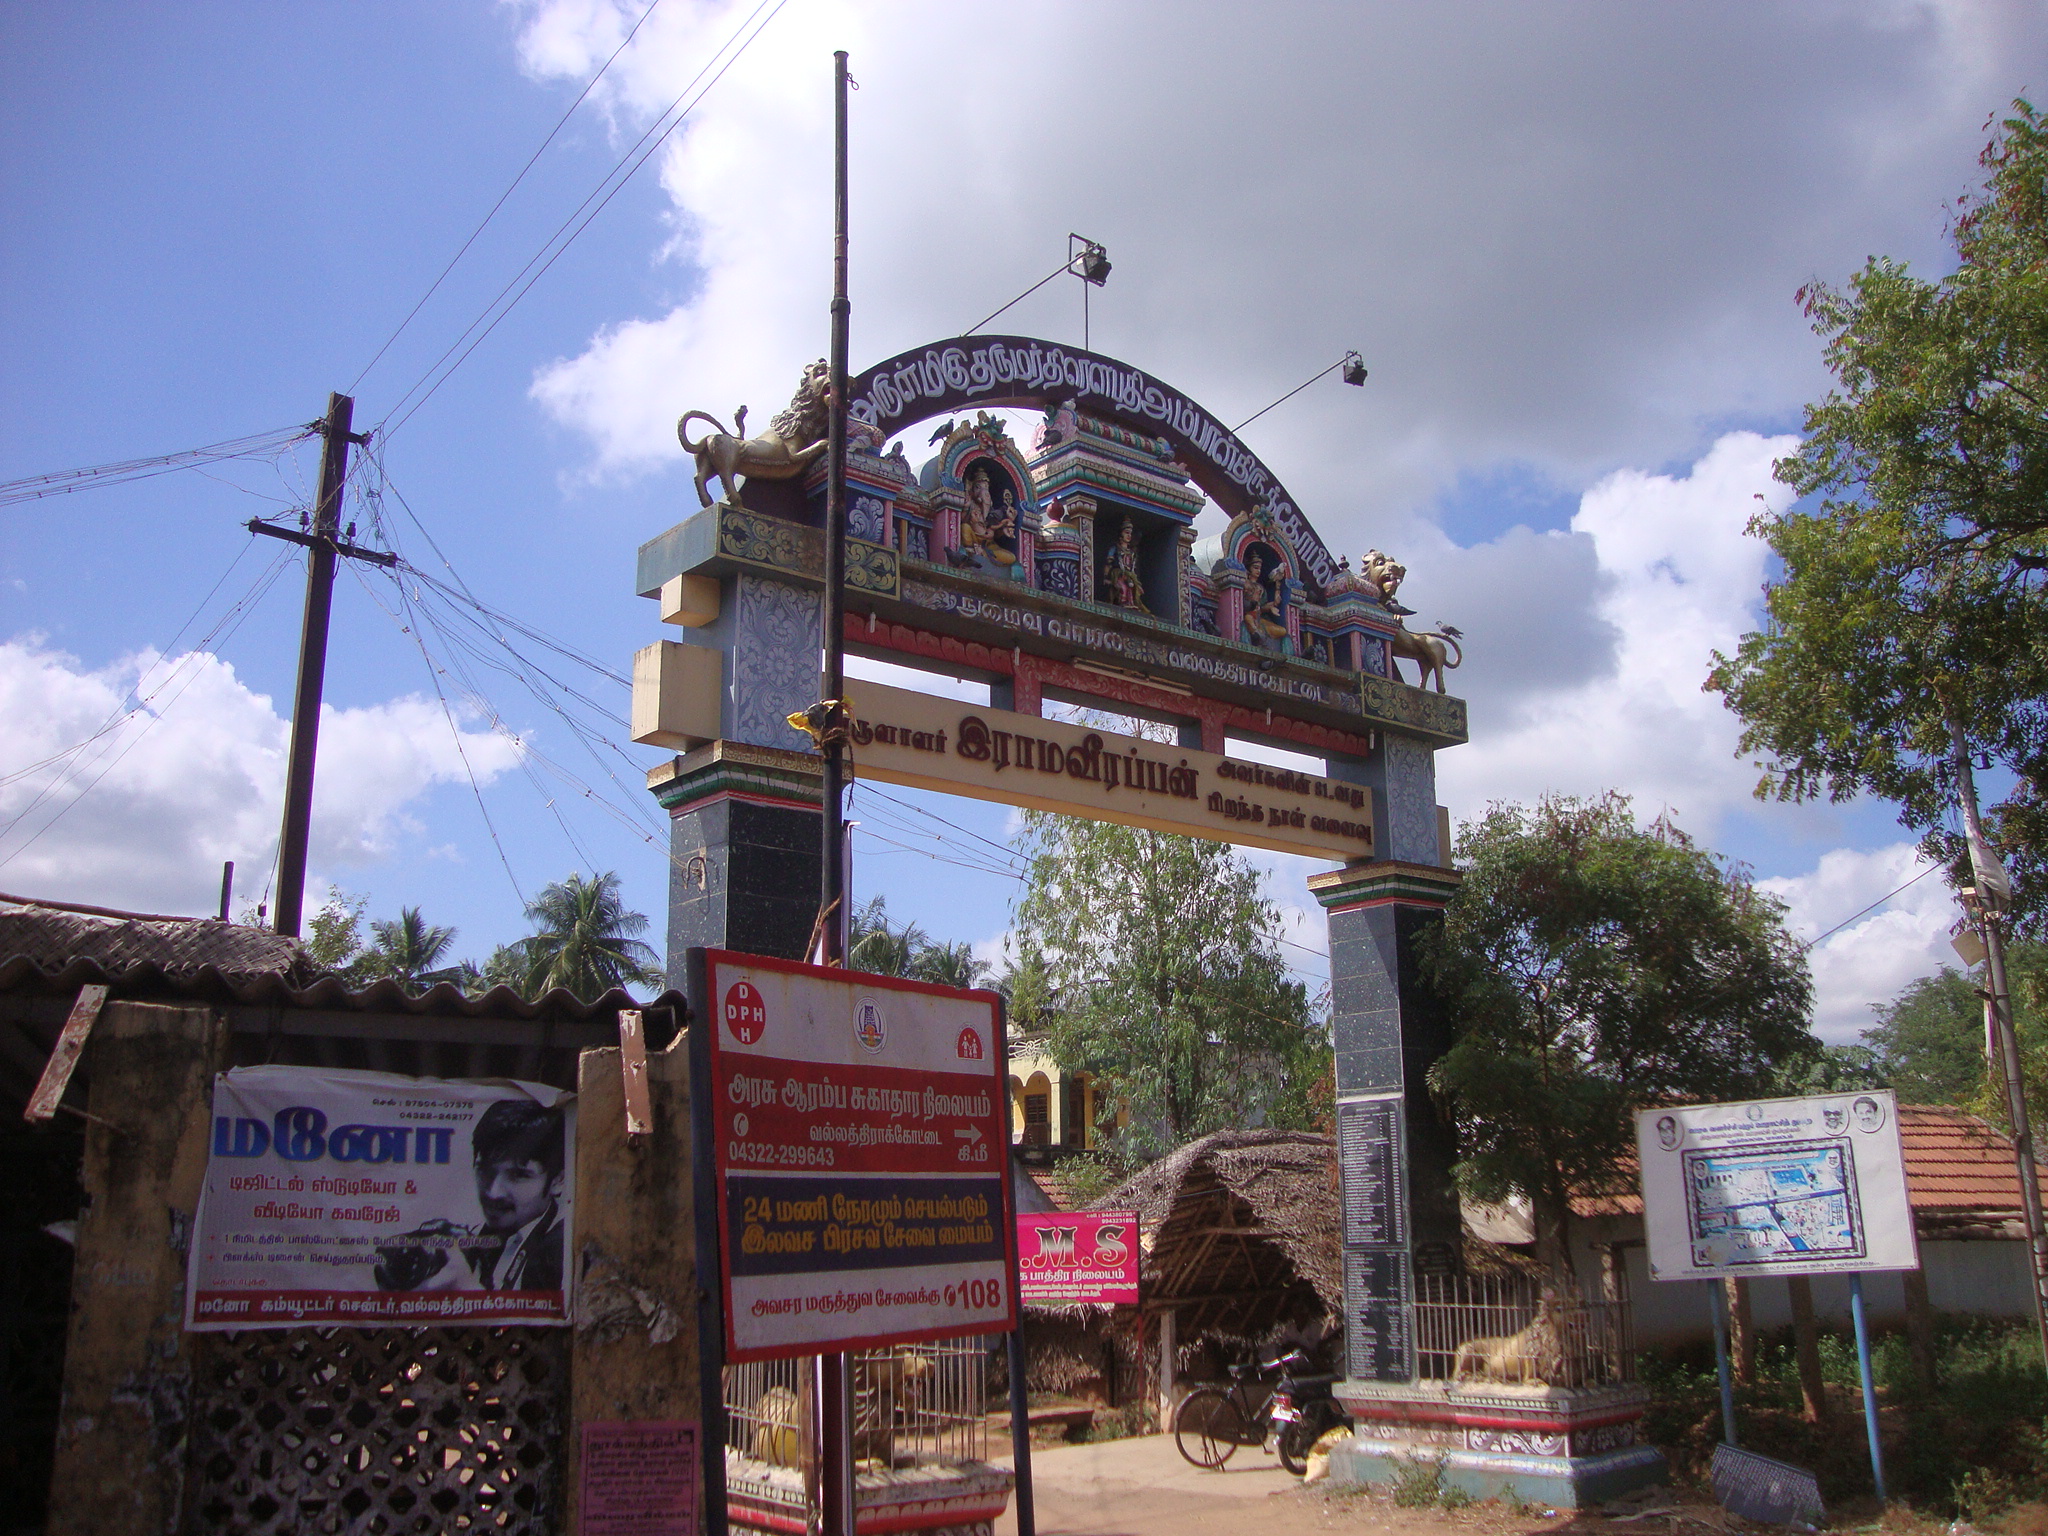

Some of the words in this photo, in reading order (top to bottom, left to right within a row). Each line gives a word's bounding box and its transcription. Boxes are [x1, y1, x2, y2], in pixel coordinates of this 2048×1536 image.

[967, 343, 1045, 396] தருமர்
[843, 717, 947, 754] ருளாளர்
[957, 716, 1199, 800] இராமவீரப்பன்
[1217, 760, 1311, 795] அவர்களின்
[1208, 791, 1264, 822] பிறந்த
[1268, 807, 1307, 829] நாள்
[1310, 815, 1372, 845] வளைவு
[728, 1073, 777, 1108] அரசு
[782, 1076, 846, 1112] ஆரம்ப
[851, 1086, 919, 1119] சுகாதார
[923, 1085, 991, 1122] நிலையம்
[213, 1106, 456, 1165] மனோ
[810, 1121, 942, 1147] வல்லத்திராக்கோட்டை
[729, 1141, 835, 1166] 04322-299643
[957, 1144, 988, 1162] கி.மீ
[230, 1174, 304, 1192] டிஜிட்டல்
[312, 1176, 397, 1196] ஸ்டுடியோ
[405, 1180, 417, 1194] &
[254, 1201, 324, 1221] வீடியோ
[331, 1205, 400, 1224] கவரேஜ்
[744, 1197, 772, 1223] 24
[777, 1195, 828, 1222] மணி
[832, 1193, 900, 1227] நேரமும்
[905, 1193, 988, 1223] செயல்படும்
[741, 1223, 816, 1254] இலவச
[823, 1223, 880, 1254] பிரசவ
[884, 1221, 935, 1247] சேவை
[939, 1219, 994, 1245] மையம்
[1030, 1269, 1070, 1283] பாத்திர
[1072, 1268, 1125, 1282] நிலையம்
[200, 1298, 249, 1312] மனோ
[751, 1298, 802, 1318] அவசர
[806, 1290, 872, 1314] மருத்துவ
[875, 1286, 940, 1307] சேவைக்கு
[958, 1278, 1001, 1310] 108
